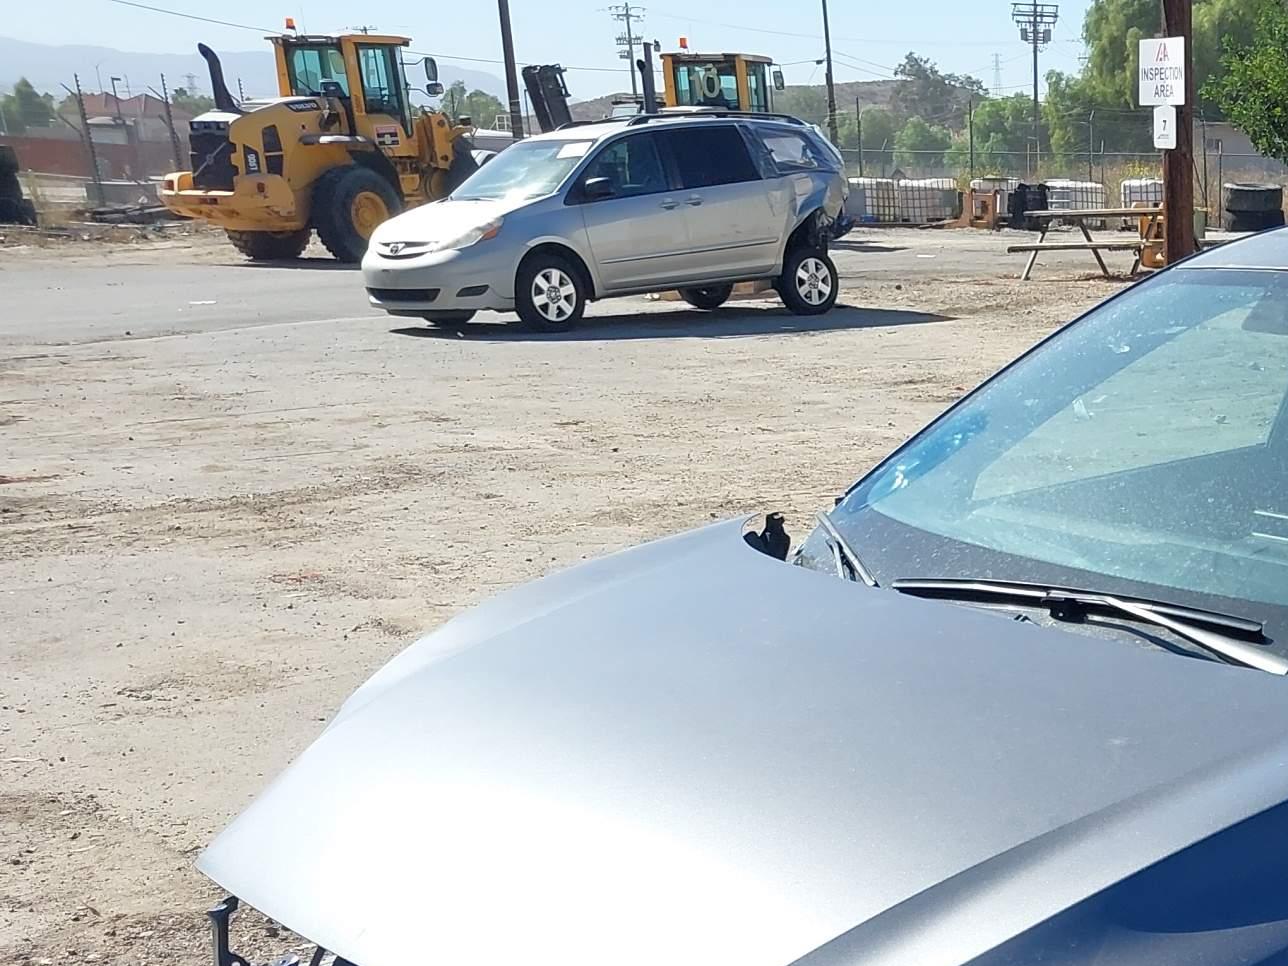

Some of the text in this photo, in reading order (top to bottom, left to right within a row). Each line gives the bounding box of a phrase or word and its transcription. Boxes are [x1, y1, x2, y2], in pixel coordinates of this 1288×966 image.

[1141, 66, 1183, 81] INSPECTION
[1153, 84, 1174, 98] AREA
[1162, 119, 1168, 131] 7
